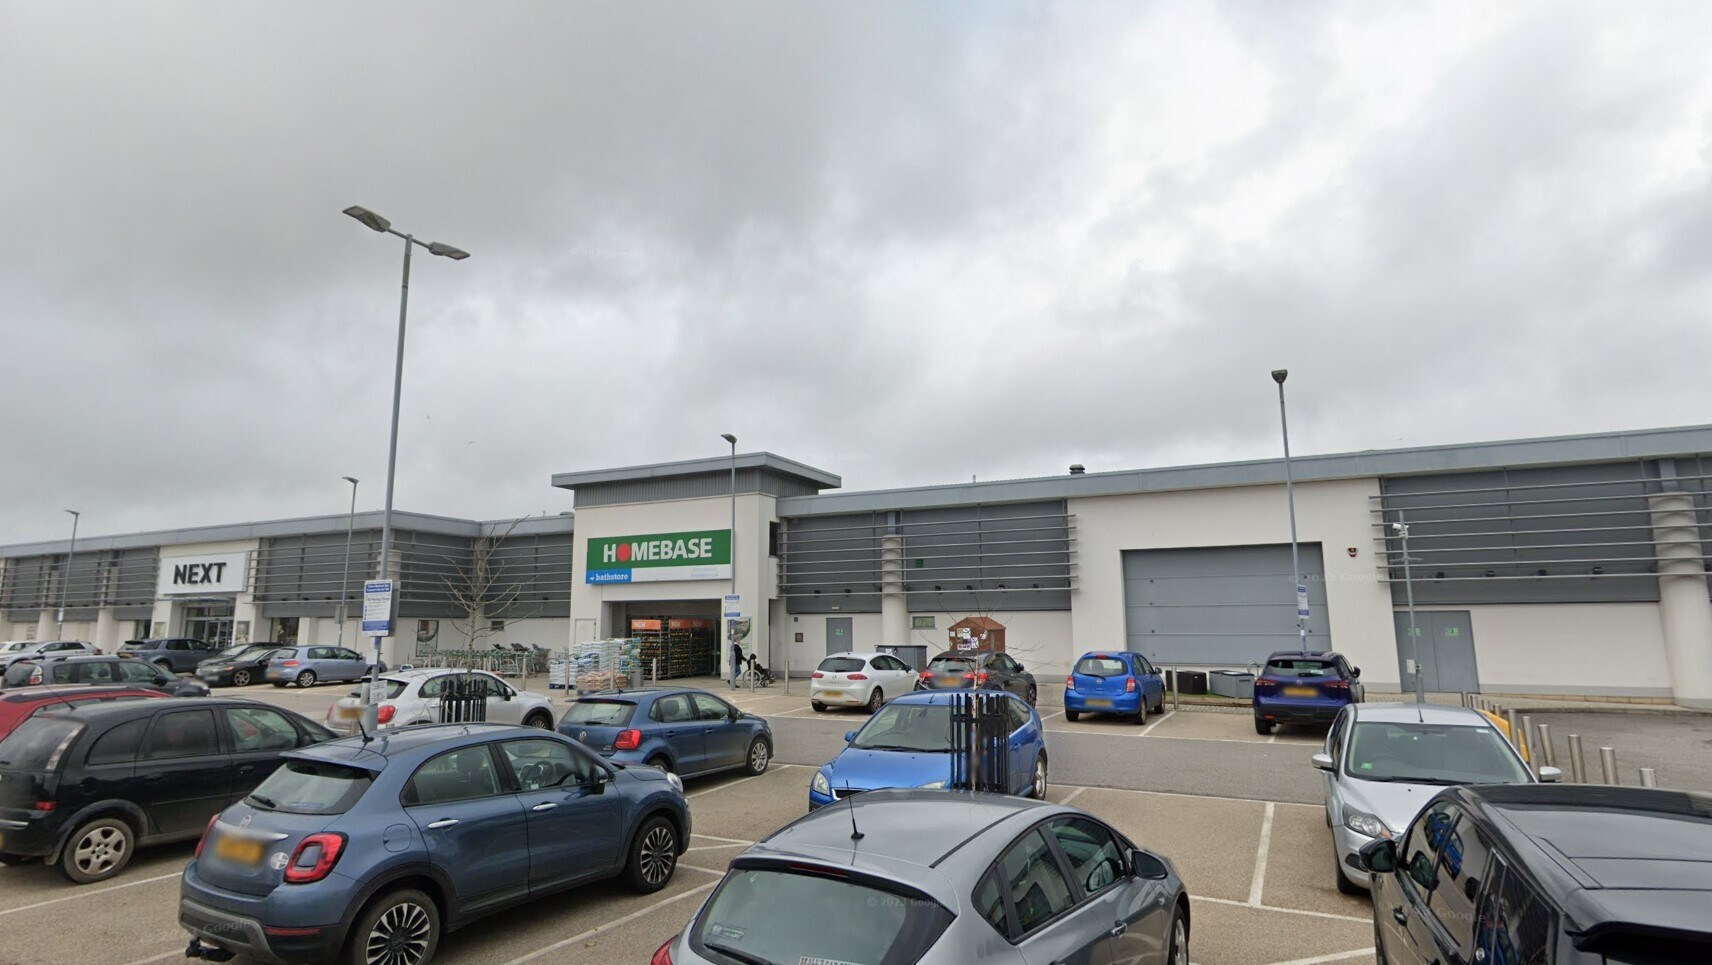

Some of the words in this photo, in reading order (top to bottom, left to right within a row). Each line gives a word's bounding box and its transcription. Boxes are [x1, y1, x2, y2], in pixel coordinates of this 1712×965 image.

[603, 538, 712, 562] HOMEBASE
[173, 562, 227, 584] NEXT
[595, 573, 628, 581] bathstore
